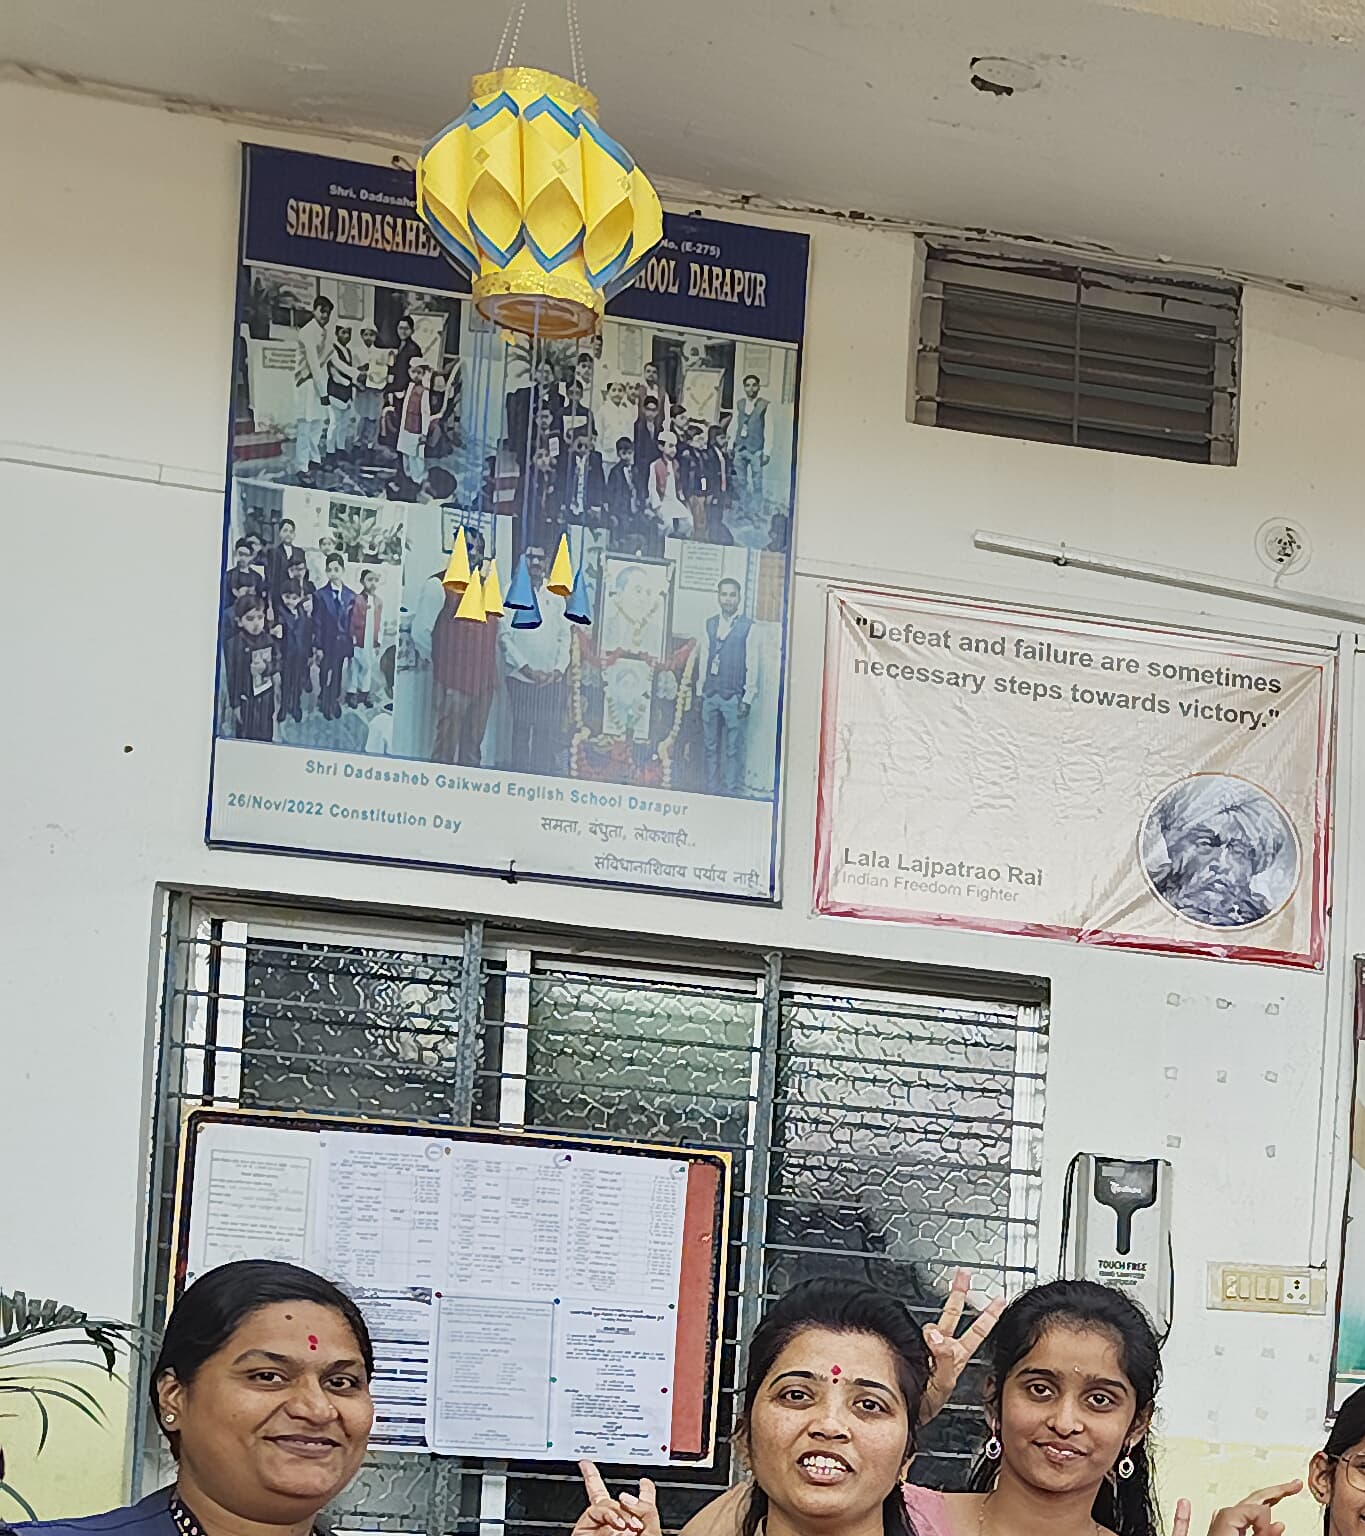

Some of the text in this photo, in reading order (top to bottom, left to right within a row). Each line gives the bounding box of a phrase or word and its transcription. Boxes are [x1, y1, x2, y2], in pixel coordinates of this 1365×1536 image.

[330, 184, 417, 207] Shri. Dadasahe
[286, 198, 333, 240] SHRI.
[681, 241, 720, 258] (E-275)
[688, 263, 766, 307] DARAPUR
[855, 614, 1282, 694] "Defeat and failure are sometimes
[855, 659, 1279, 731] necessary steps towards victory."
[305, 760, 688, 816] Shri Dadasaheb Gaikwad English School Darapur
[228, 793, 462, 834] 26/Nov/2022 Constitution Day
[843, 871, 1019, 902] Indian Freedom Fighter
[844, 847, 1042, 886] Lala Lajpatrao Rai
[1098, 1259, 1147, 1272] TOUCH FREE
